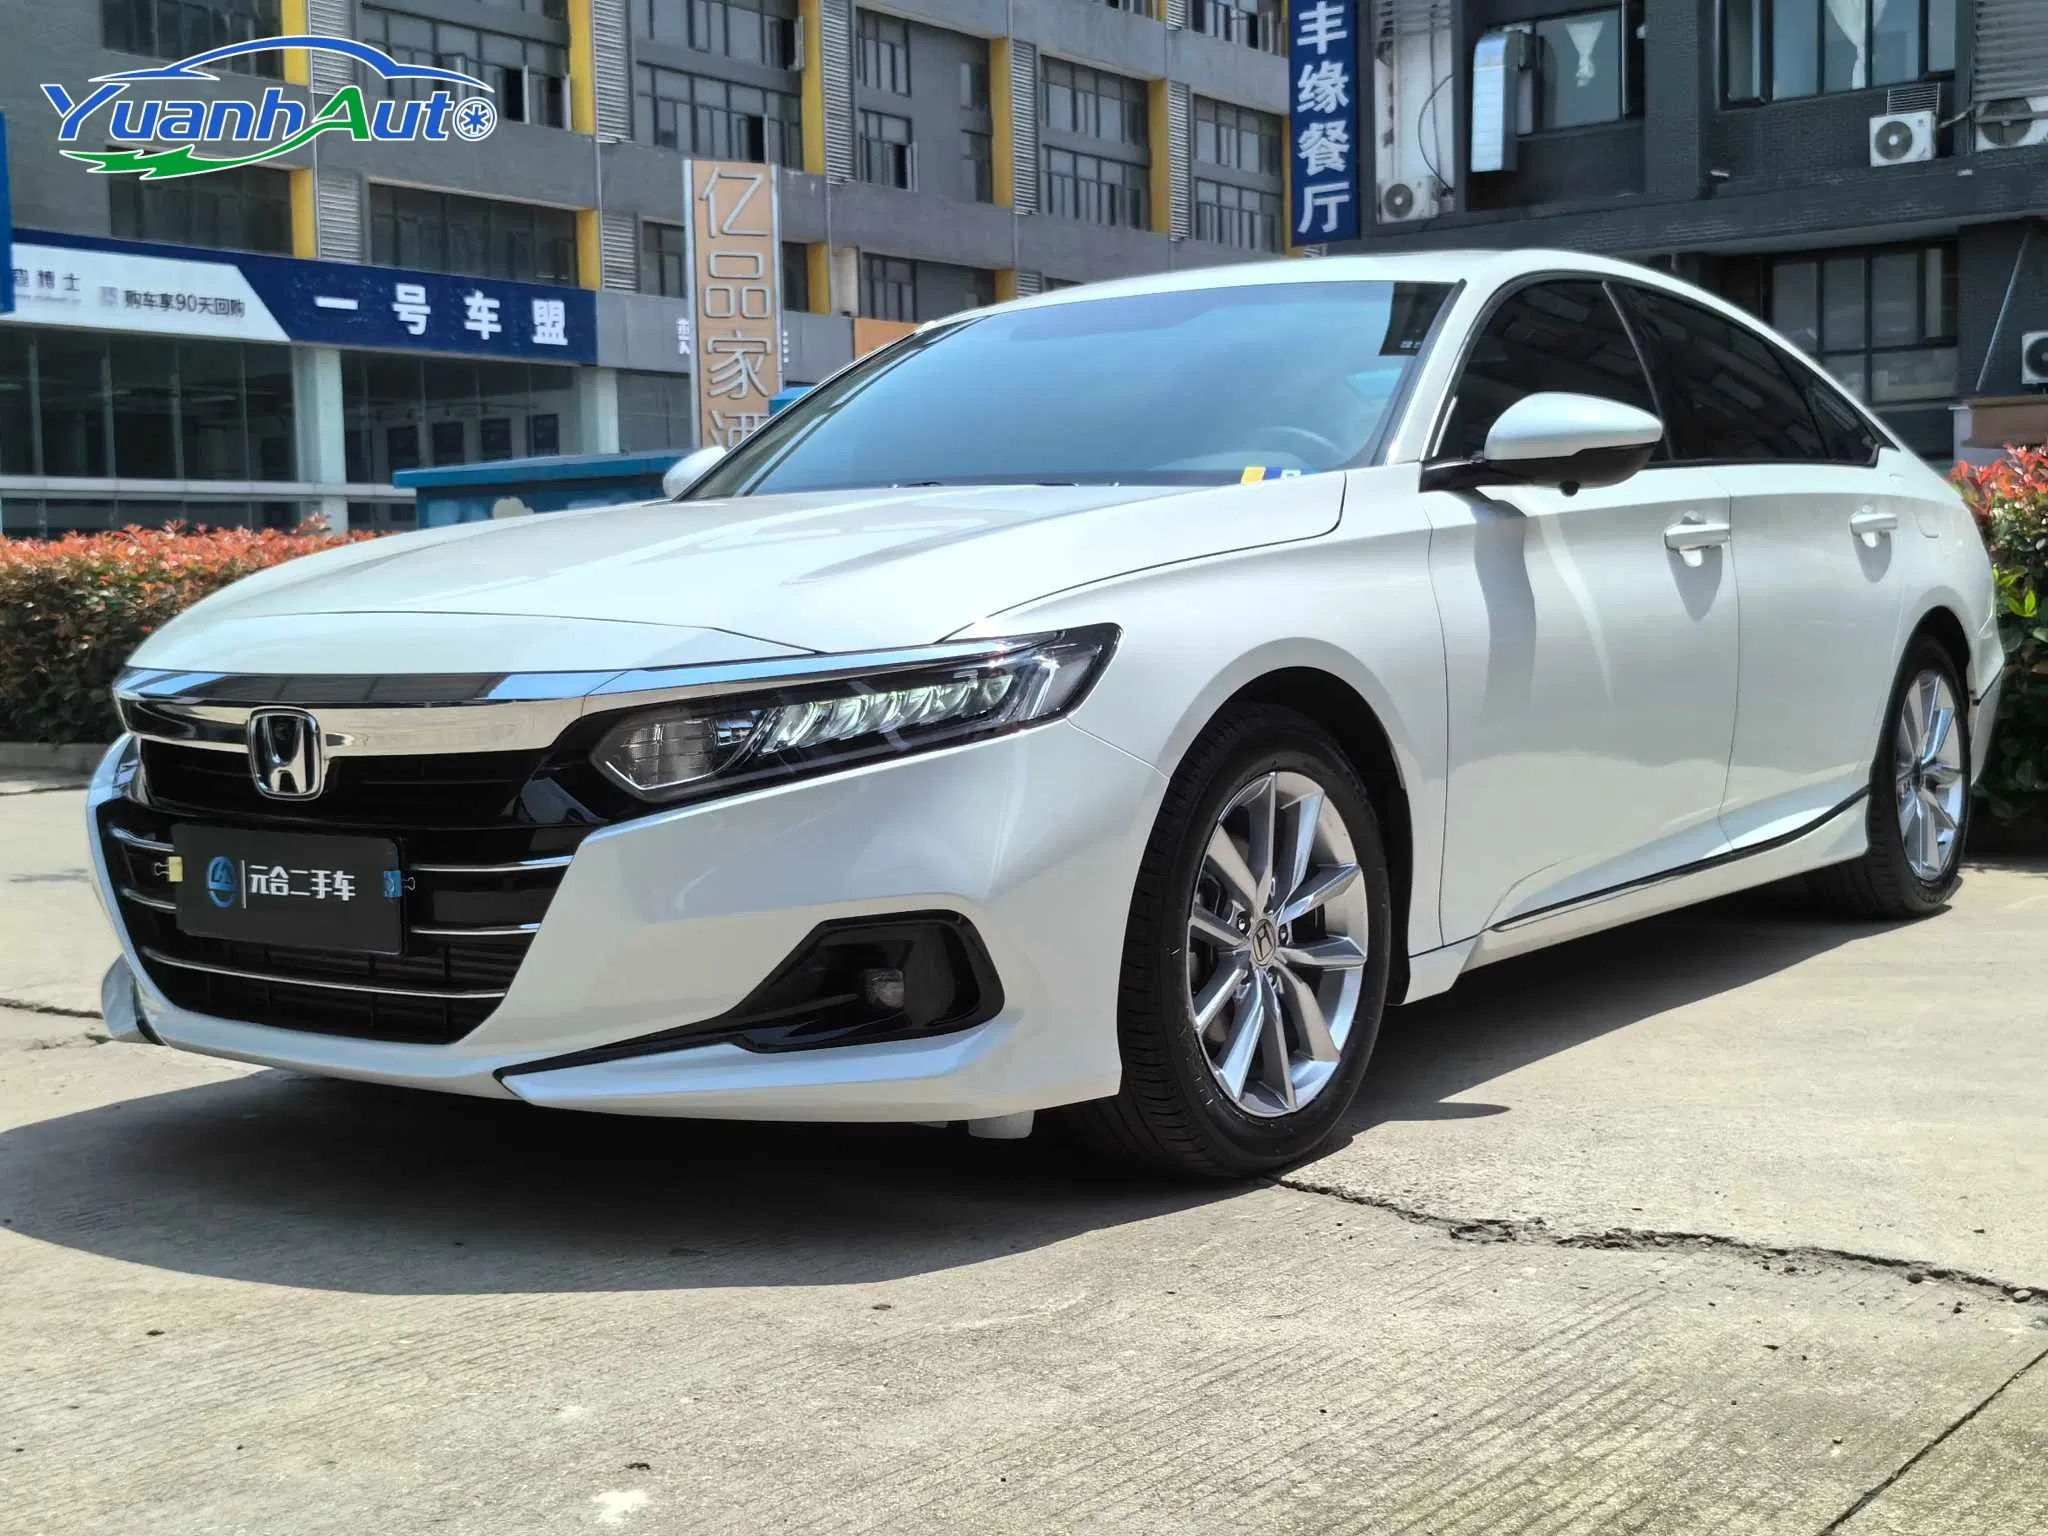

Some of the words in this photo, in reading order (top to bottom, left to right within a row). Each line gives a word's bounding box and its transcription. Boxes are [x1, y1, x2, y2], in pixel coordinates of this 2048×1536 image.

[1297, 1, 1349, 234] 丰缘餐厅
[314, 282, 568, 346] 一号车盟
